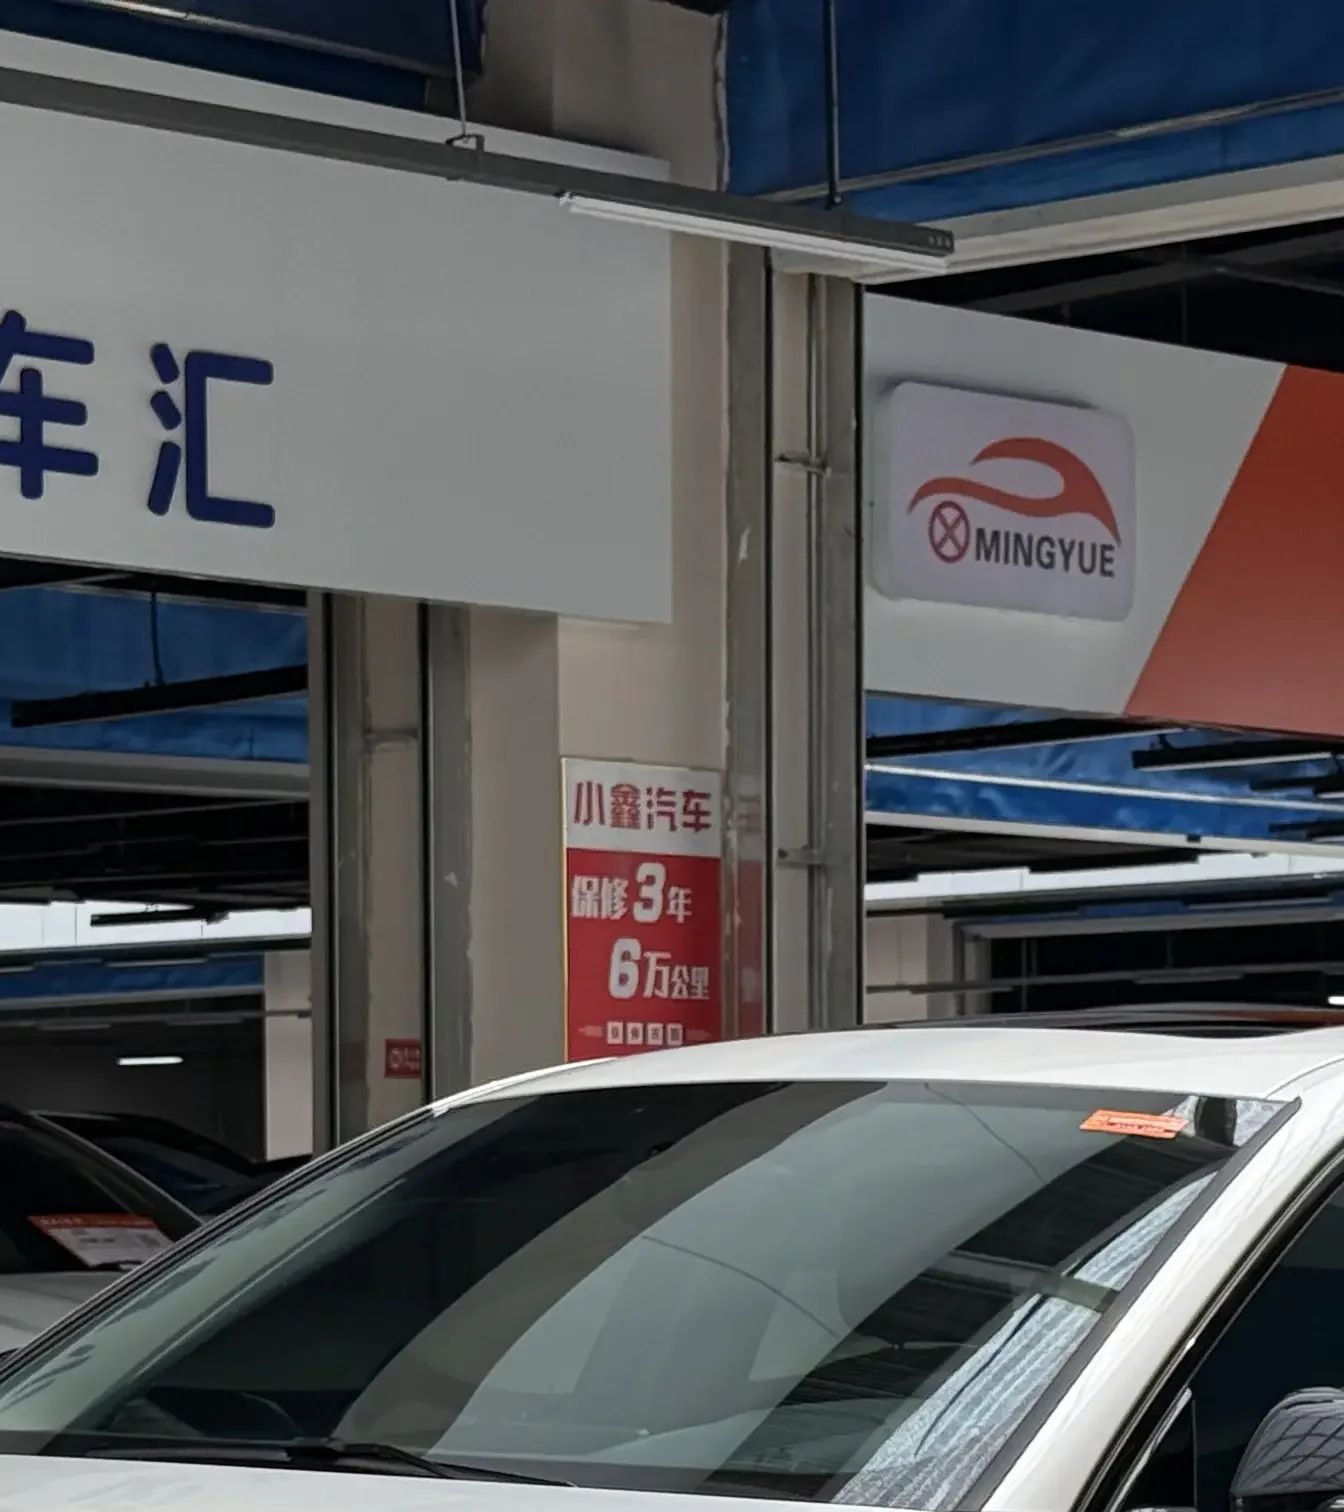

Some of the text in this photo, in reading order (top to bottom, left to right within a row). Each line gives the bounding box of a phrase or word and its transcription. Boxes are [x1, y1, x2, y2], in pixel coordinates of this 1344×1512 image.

[973, 526, 1116, 579] MINGYUE
[573, 780, 712, 833] 小鑫汽车
[571, 861, 693, 923] 保修3年
[607, 936, 710, 1001] 6万公里
